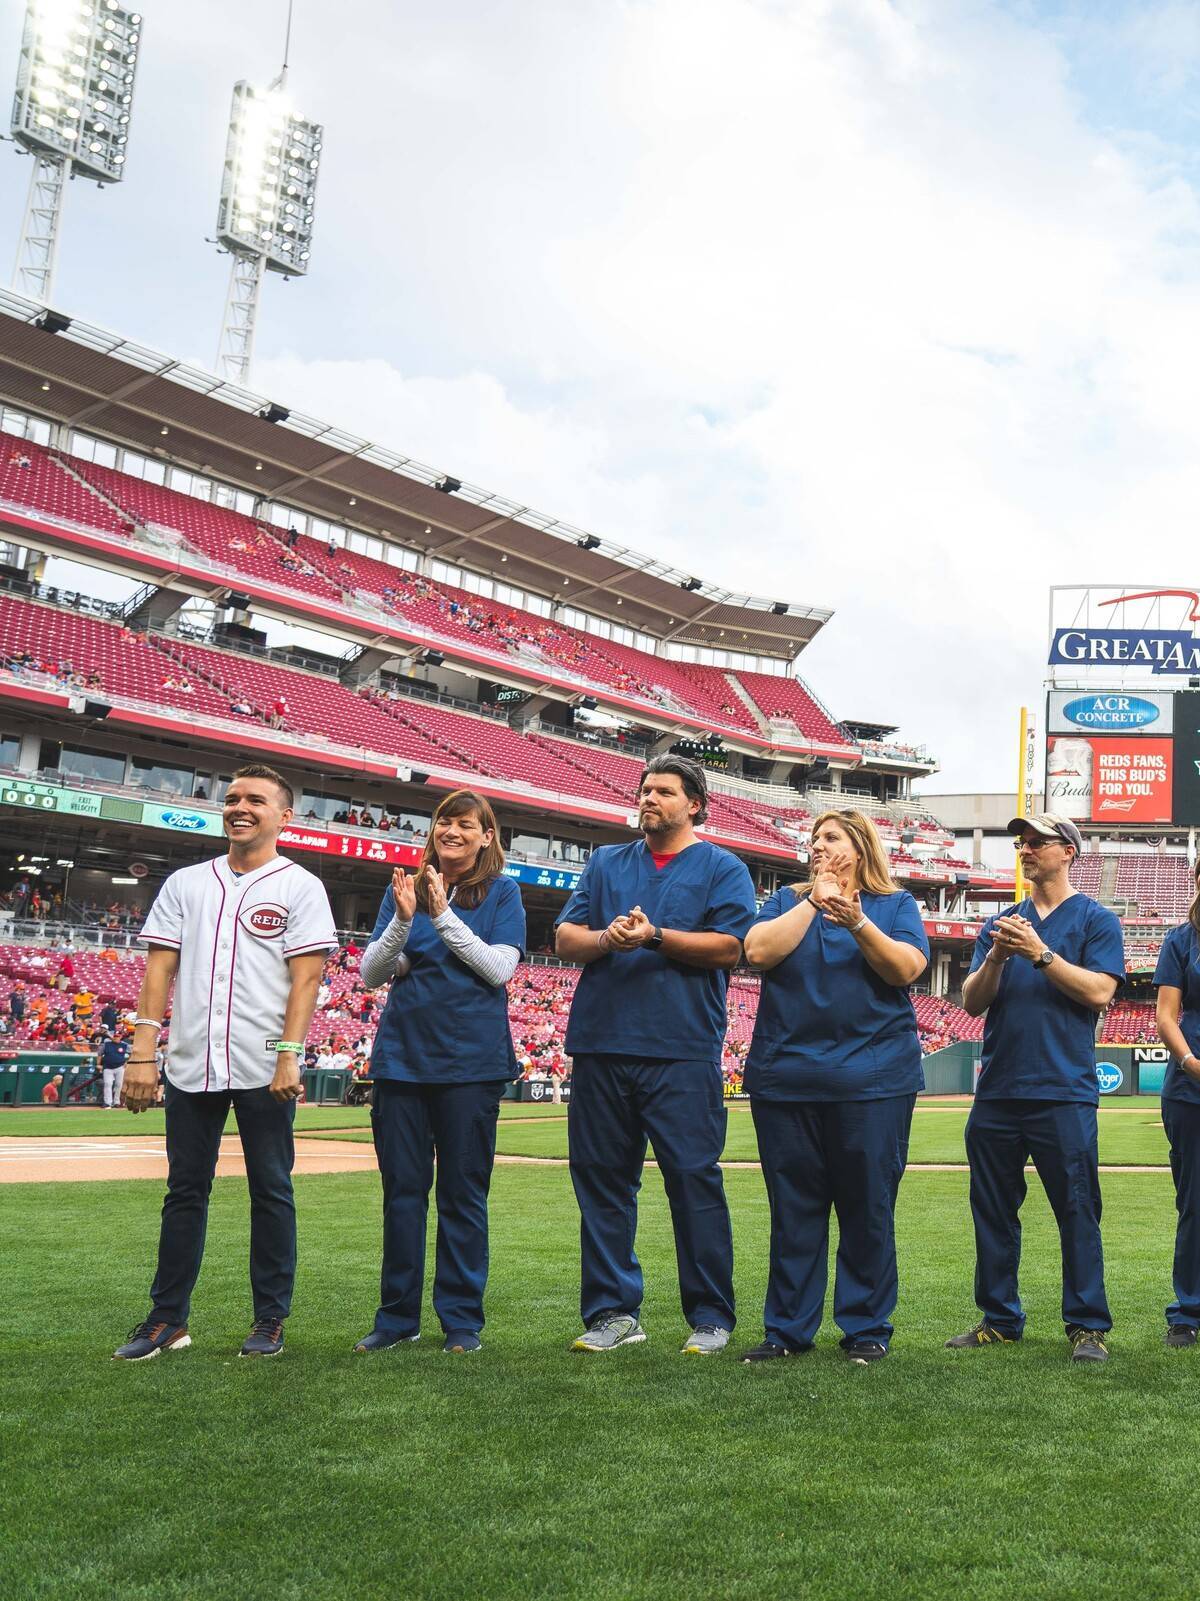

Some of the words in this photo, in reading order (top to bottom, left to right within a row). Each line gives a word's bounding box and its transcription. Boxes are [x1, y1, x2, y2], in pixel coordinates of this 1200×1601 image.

[1057, 631, 1174, 661] GREAT
[1092, 697, 1129, 711] ACR
[1076, 710, 1144, 724] CONCRETE
[1099, 753, 1128, 768] REDS
[1131, 754, 1167, 770] FANS,
[1098, 769, 1127, 782] THIS
[1129, 769, 1167, 783] BUD'S
[1098, 783, 1123, 796] FOR
[1126, 783, 1154, 796] YOU.
[169, 812, 199, 828] Ford
[252, 914, 288, 927] REDS
